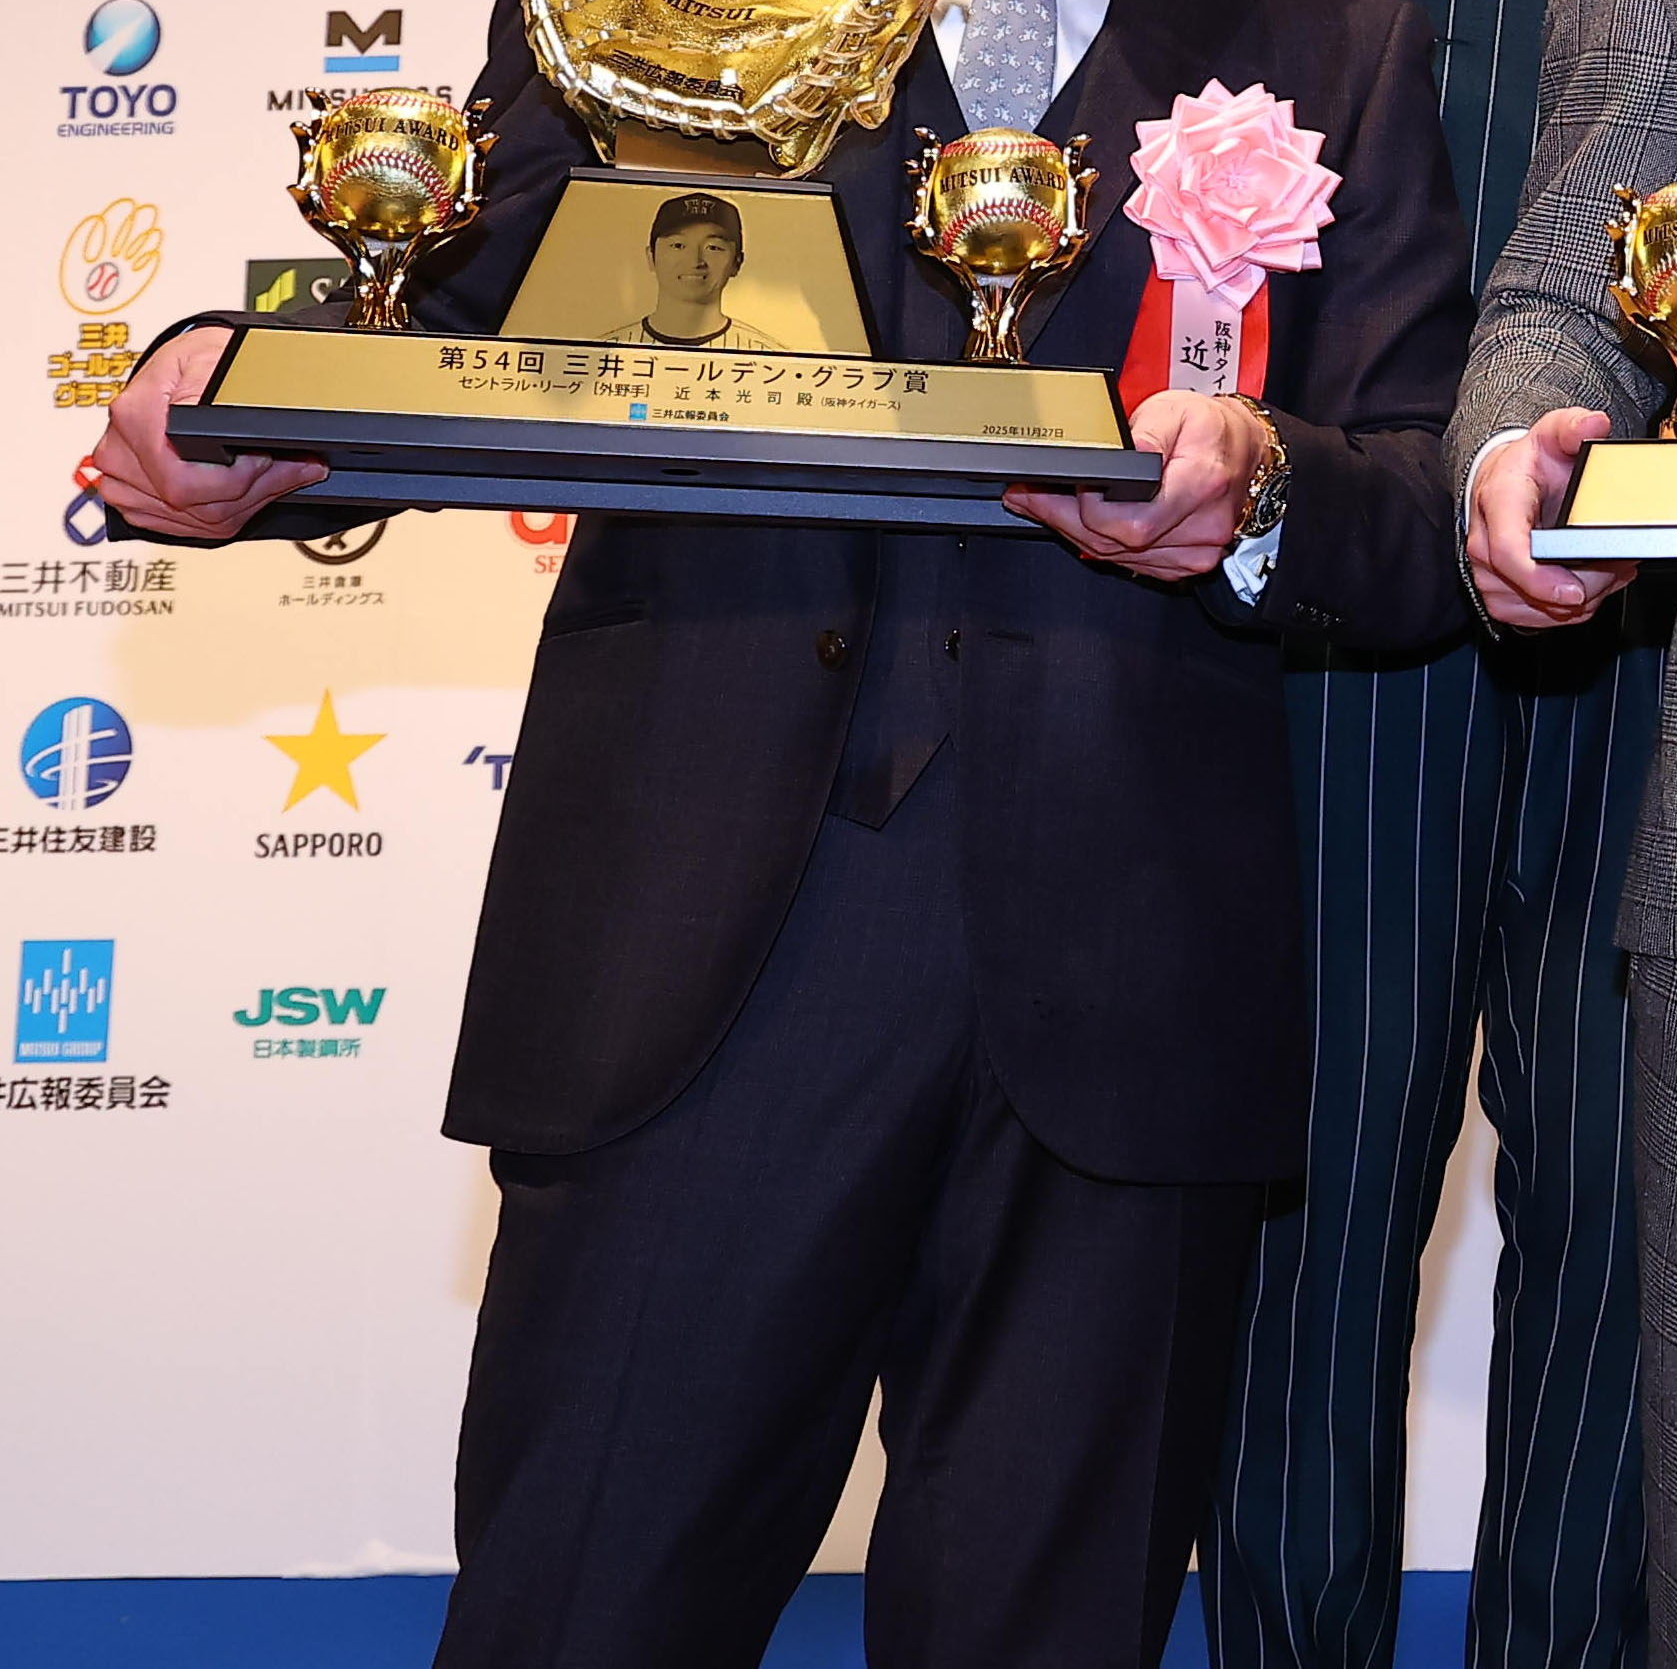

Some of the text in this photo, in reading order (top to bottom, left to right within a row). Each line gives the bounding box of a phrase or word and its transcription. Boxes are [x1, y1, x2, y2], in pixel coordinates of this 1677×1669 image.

[60, 84, 176, 119] TOYO
[57, 120, 174, 138] ENGINEERING
[394, 117, 460, 152] AWARD
[938, 166, 1066, 196] MITSUI AWARD
[438, 345, 930, 394] 第54回 三井ゴールデン・グラブ賞
[458, 375, 583, 395] セントラル・リーグ
[675, 385, 812, 407] 近本光司殿
[982, 424, 1065, 439] 2025年11月27日
[1, 559, 177, 594] 三井不動産
[74, 599, 174, 616] FUDOSAN
[255, 832, 383, 858] SAPPORO
[233, 987, 388, 1026] JSW
[0, 1075, 172, 1111] 広報委員会
